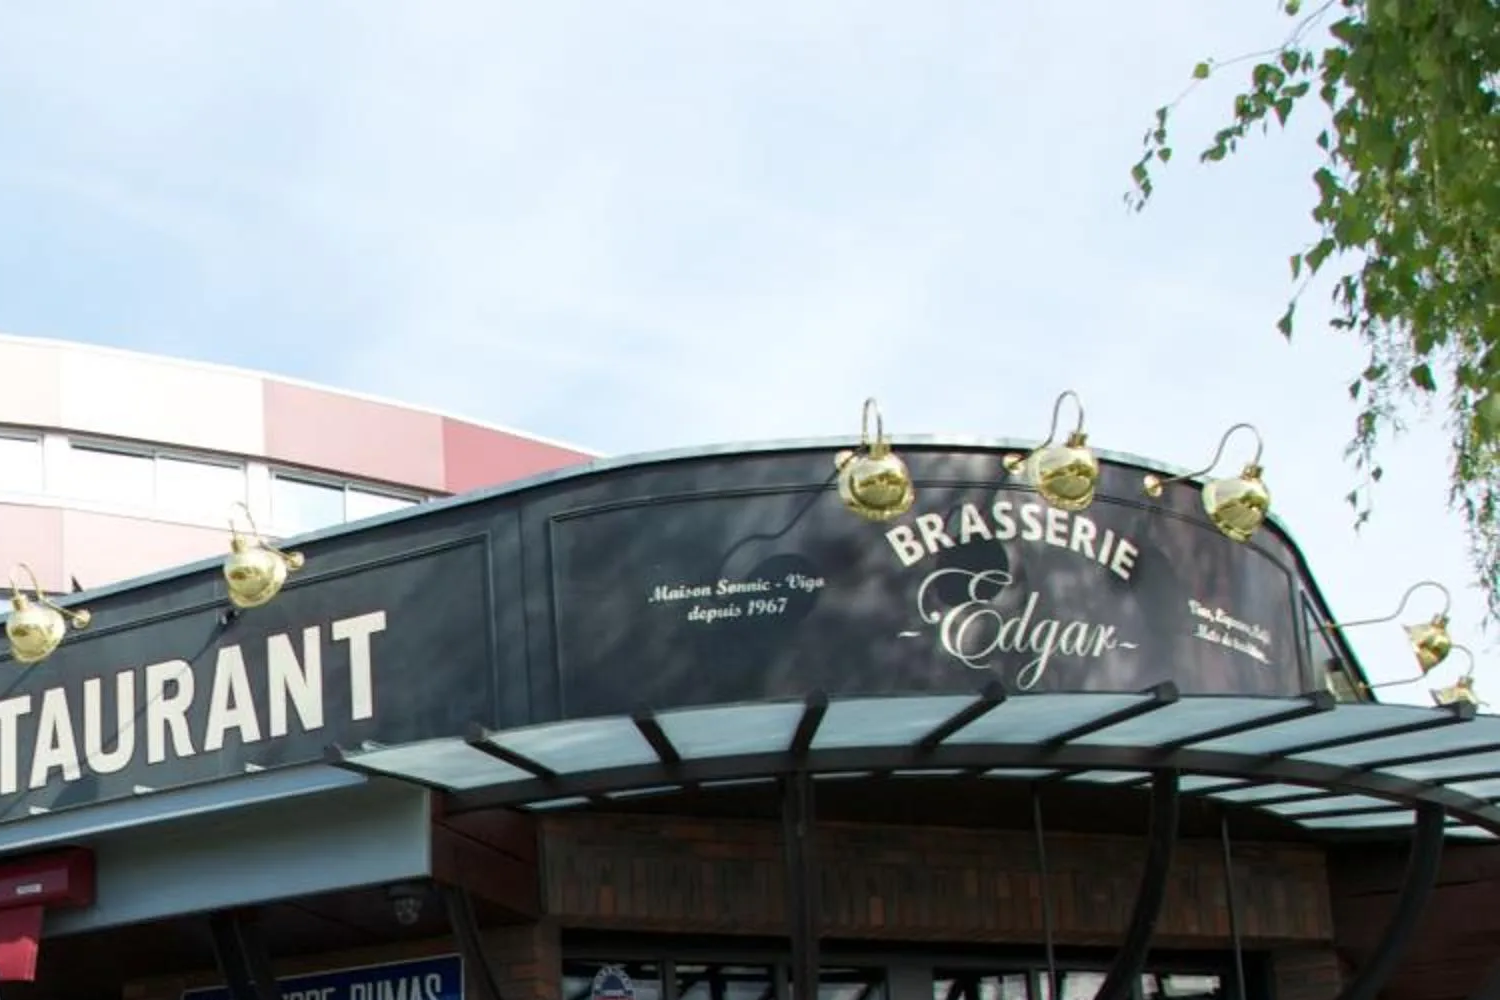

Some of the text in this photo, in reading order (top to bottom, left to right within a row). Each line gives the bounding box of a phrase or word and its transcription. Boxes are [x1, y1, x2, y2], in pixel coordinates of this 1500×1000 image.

[885, 501, 1139, 580] BRASSERIE
[687, 597, 789, 623] depuis 1967
